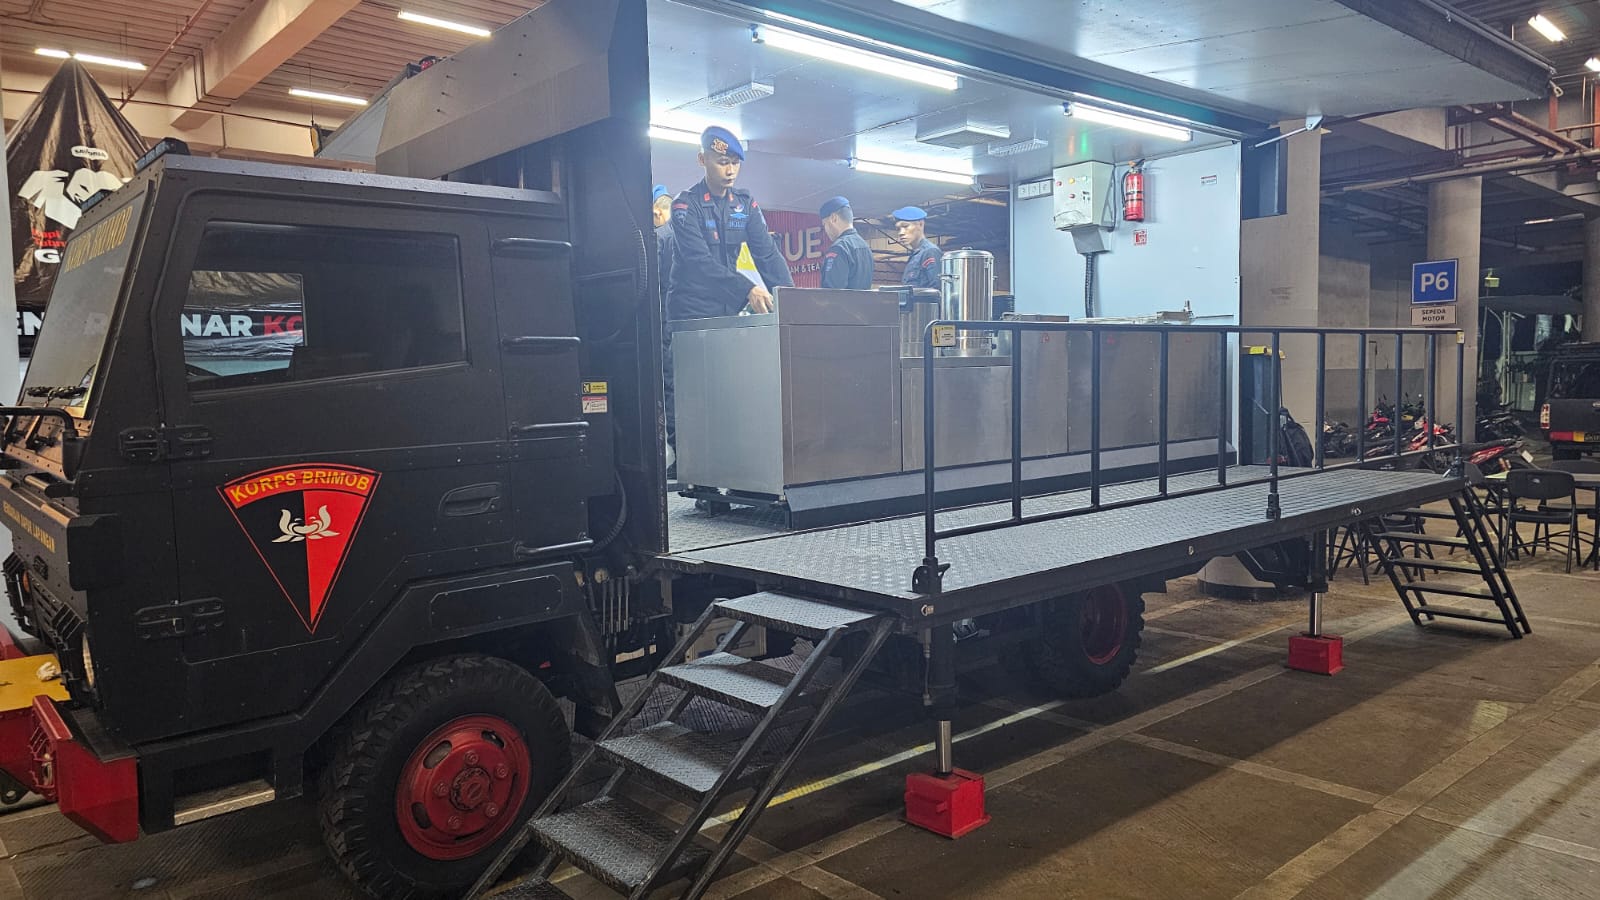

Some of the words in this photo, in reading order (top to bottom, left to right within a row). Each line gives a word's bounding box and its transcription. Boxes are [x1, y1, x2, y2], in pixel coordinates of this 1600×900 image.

[1420, 271, 1449, 293] P6
[1421, 308, 1446, 316] SEPEDA
[230, 472, 297, 502] KORPS
[302, 470, 370, 491] BRIMOB
